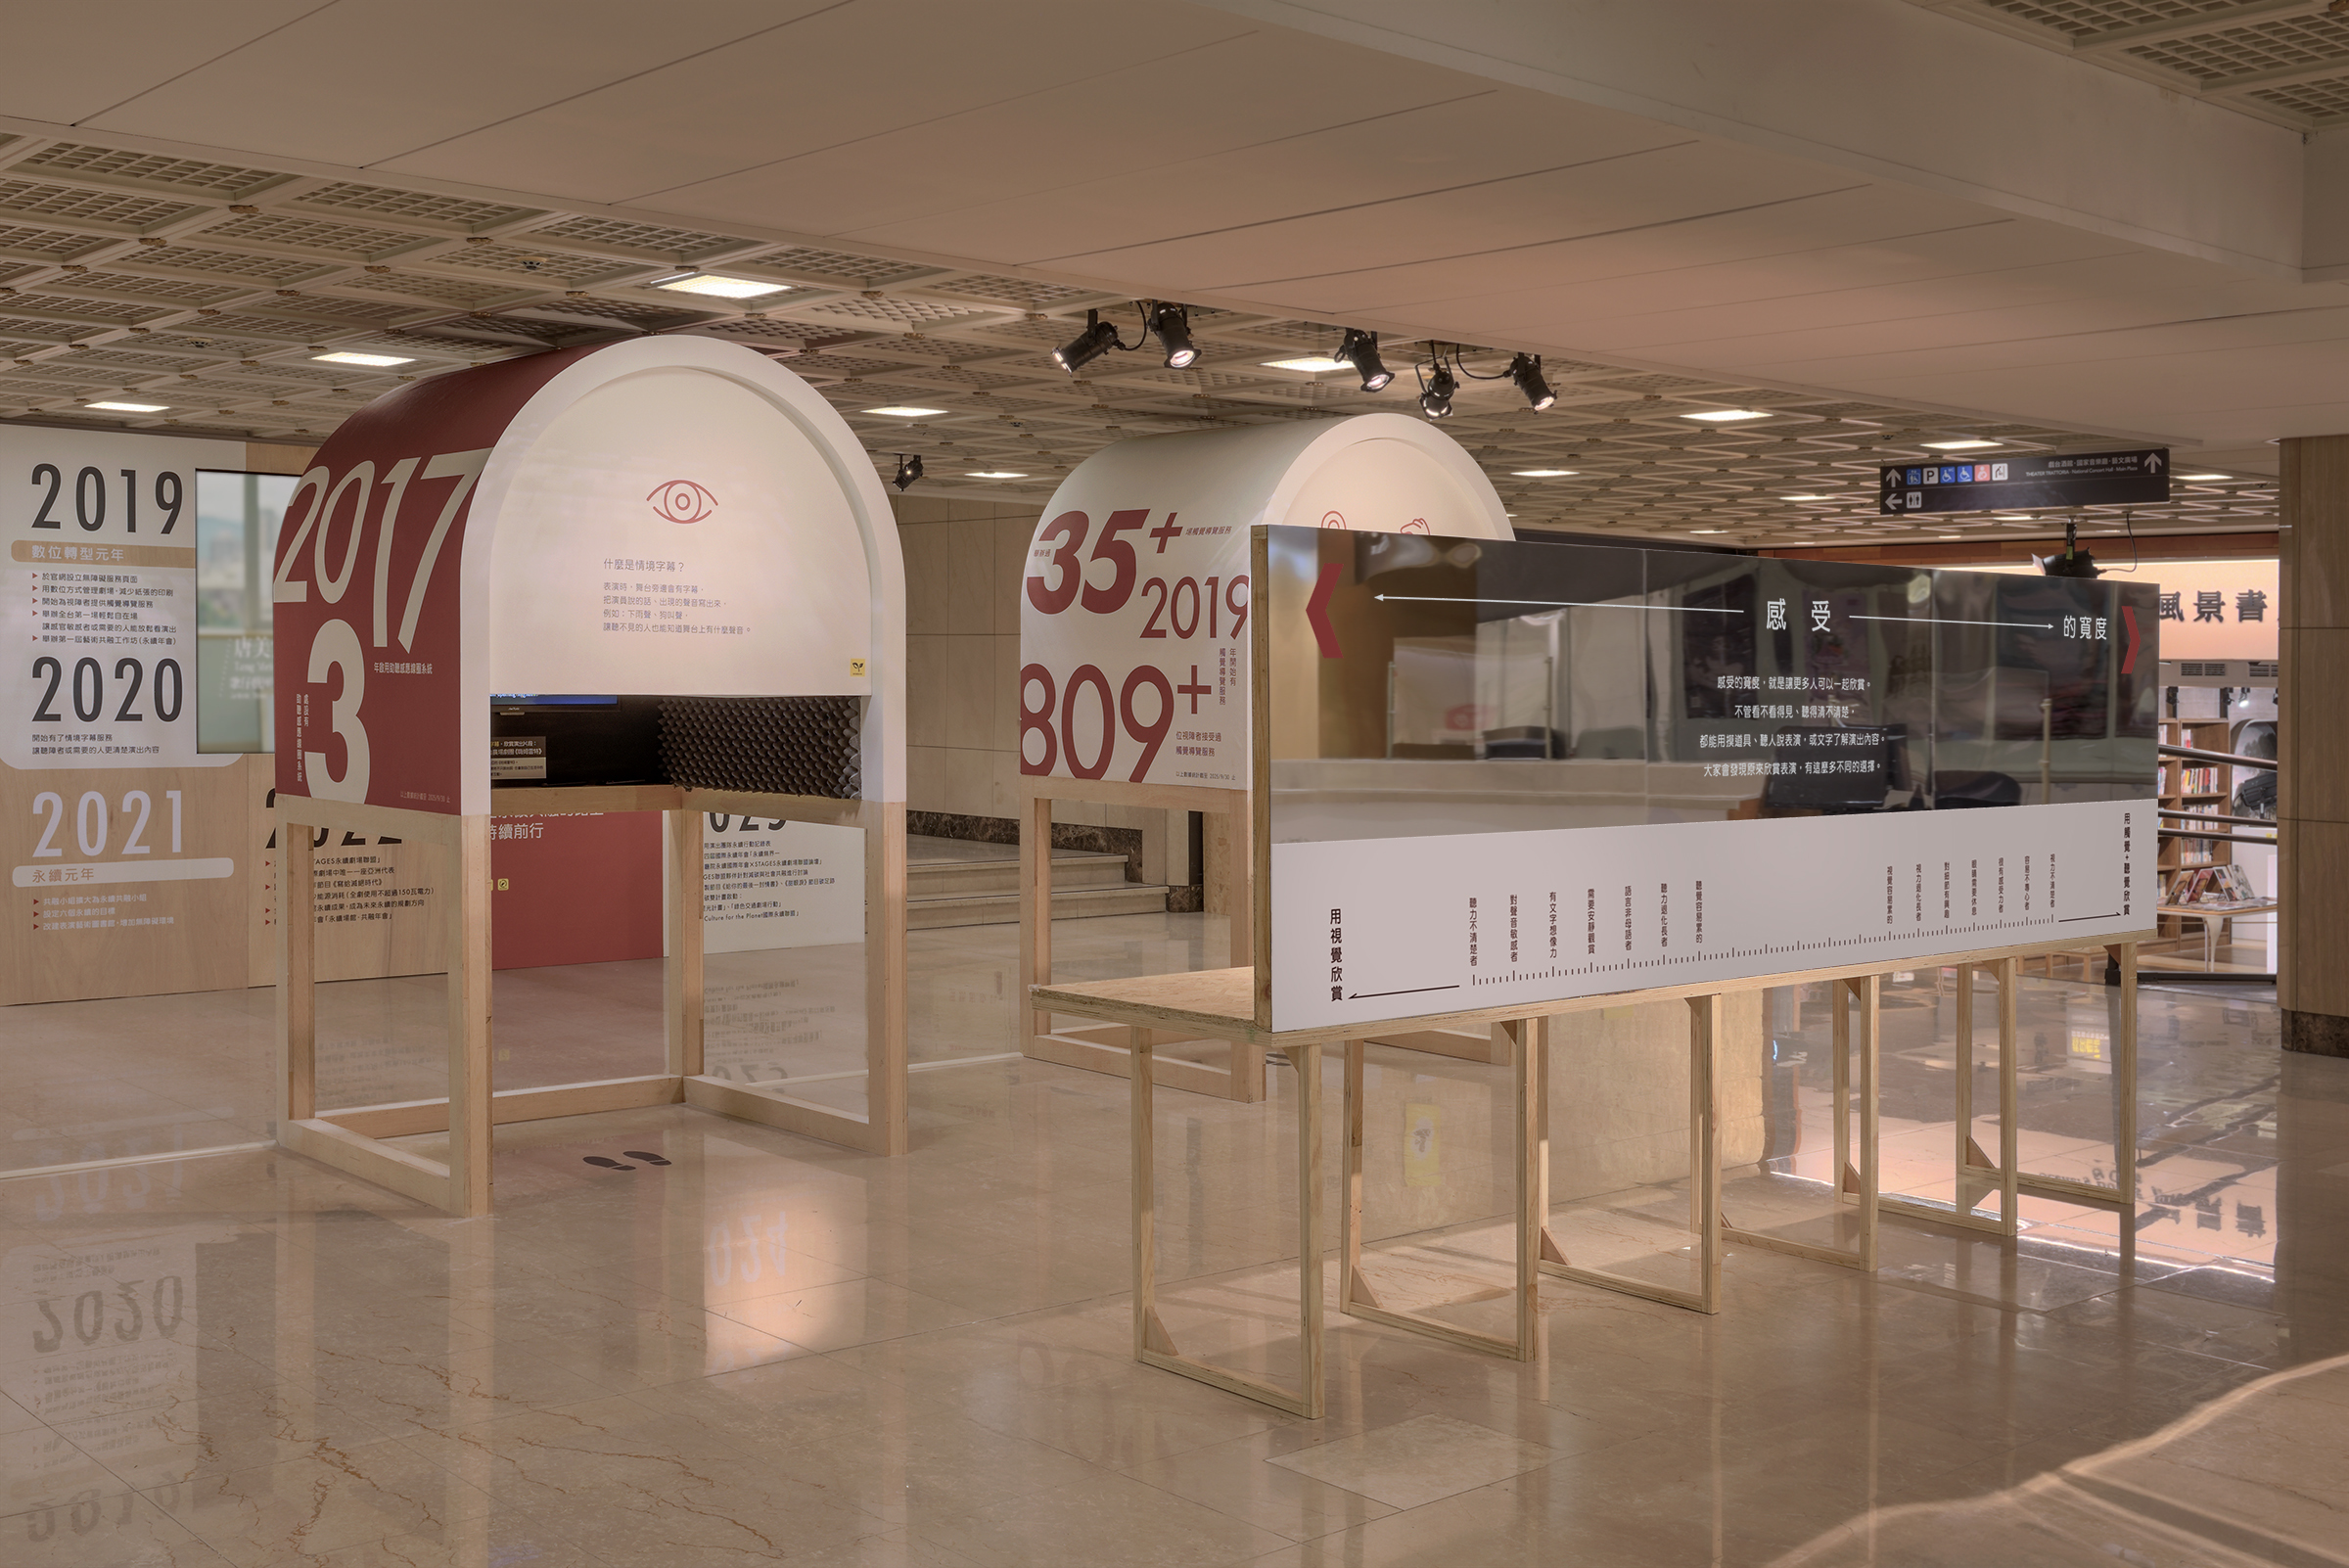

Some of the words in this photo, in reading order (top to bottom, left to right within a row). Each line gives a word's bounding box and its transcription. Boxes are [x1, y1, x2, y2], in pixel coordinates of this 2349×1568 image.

[31, 462, 184, 535] 2019
[32, 545, 125, 562] 數位轉型元年
[273, 447, 495, 654] 2017
[1027, 508, 1183, 615] 35+
[1139, 575, 1249, 640] 2019
[2064, 615, 2108, 640] 的寬度
[234, 637, 273, 659] 唐美
[31, 656, 184, 723] 2020
[304, 619, 370, 804] 3
[32, 734, 113, 742] 開始有了情境字幕服務
[32, 790, 182, 858] 2021
[32, 868, 94, 883] 永續元年
[1330, 908, 1343, 1002] 用視覺欣賞
[1469, 898, 1477, 966] 聽力不清楚者
